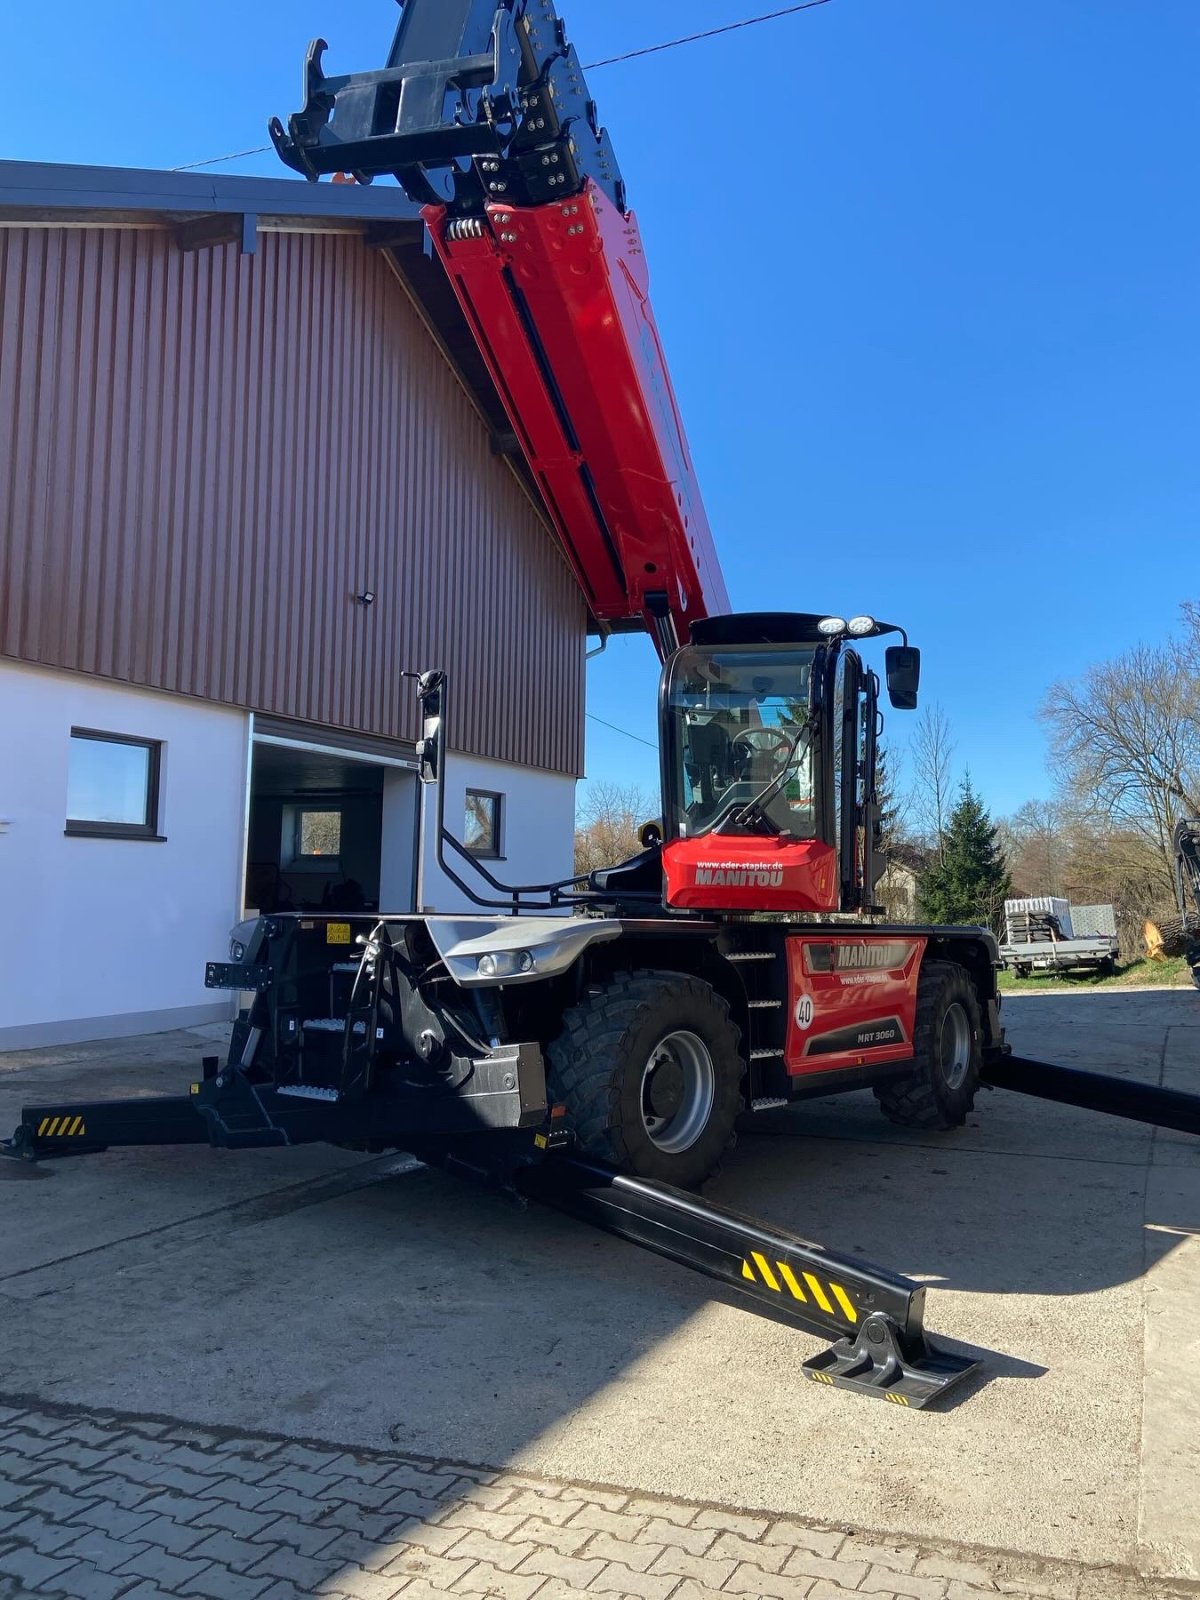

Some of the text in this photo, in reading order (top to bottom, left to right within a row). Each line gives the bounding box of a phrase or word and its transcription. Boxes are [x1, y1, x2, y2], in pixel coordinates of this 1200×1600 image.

[697, 861, 783, 871] www.eder-stapler.de
[695, 869, 784, 887] MANITOU
[838, 945, 891, 967] MANITOU
[798, 1001, 811, 1023] 40
[857, 1029, 895, 1043] MRT 3060
